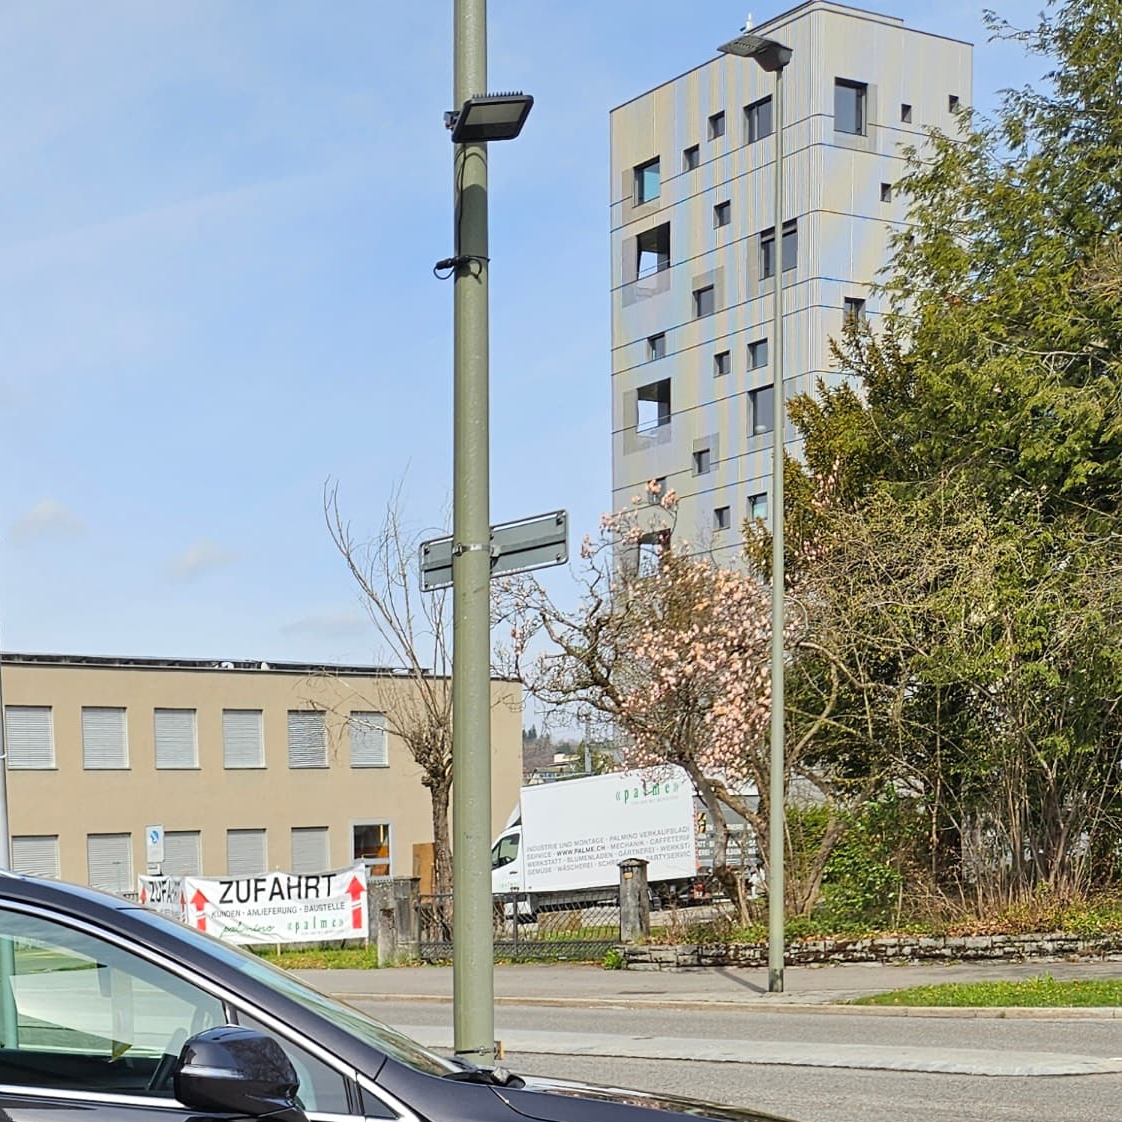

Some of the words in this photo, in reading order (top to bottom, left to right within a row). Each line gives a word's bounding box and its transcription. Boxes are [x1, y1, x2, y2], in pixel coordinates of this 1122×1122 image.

[574, 837, 605, 846] MONTAGE
[609, 833, 638, 842] PALMINO
[639, 826, 690, 838] VERKAUFSLAD
[526, 851, 552, 860] SERVICE
[556, 845, 606, 856] WWW.PALME.CH
[610, 840, 644, 850] MECHANIK
[527, 858, 562, 868] WERKSTATT
[218, 873, 337, 904] ZUFAHRT
[211, 909, 241, 919] KUNDEN
[247, 905, 298, 916] ANLIEFERUNG
[303, 901, 346, 913] BAUSTELLE
